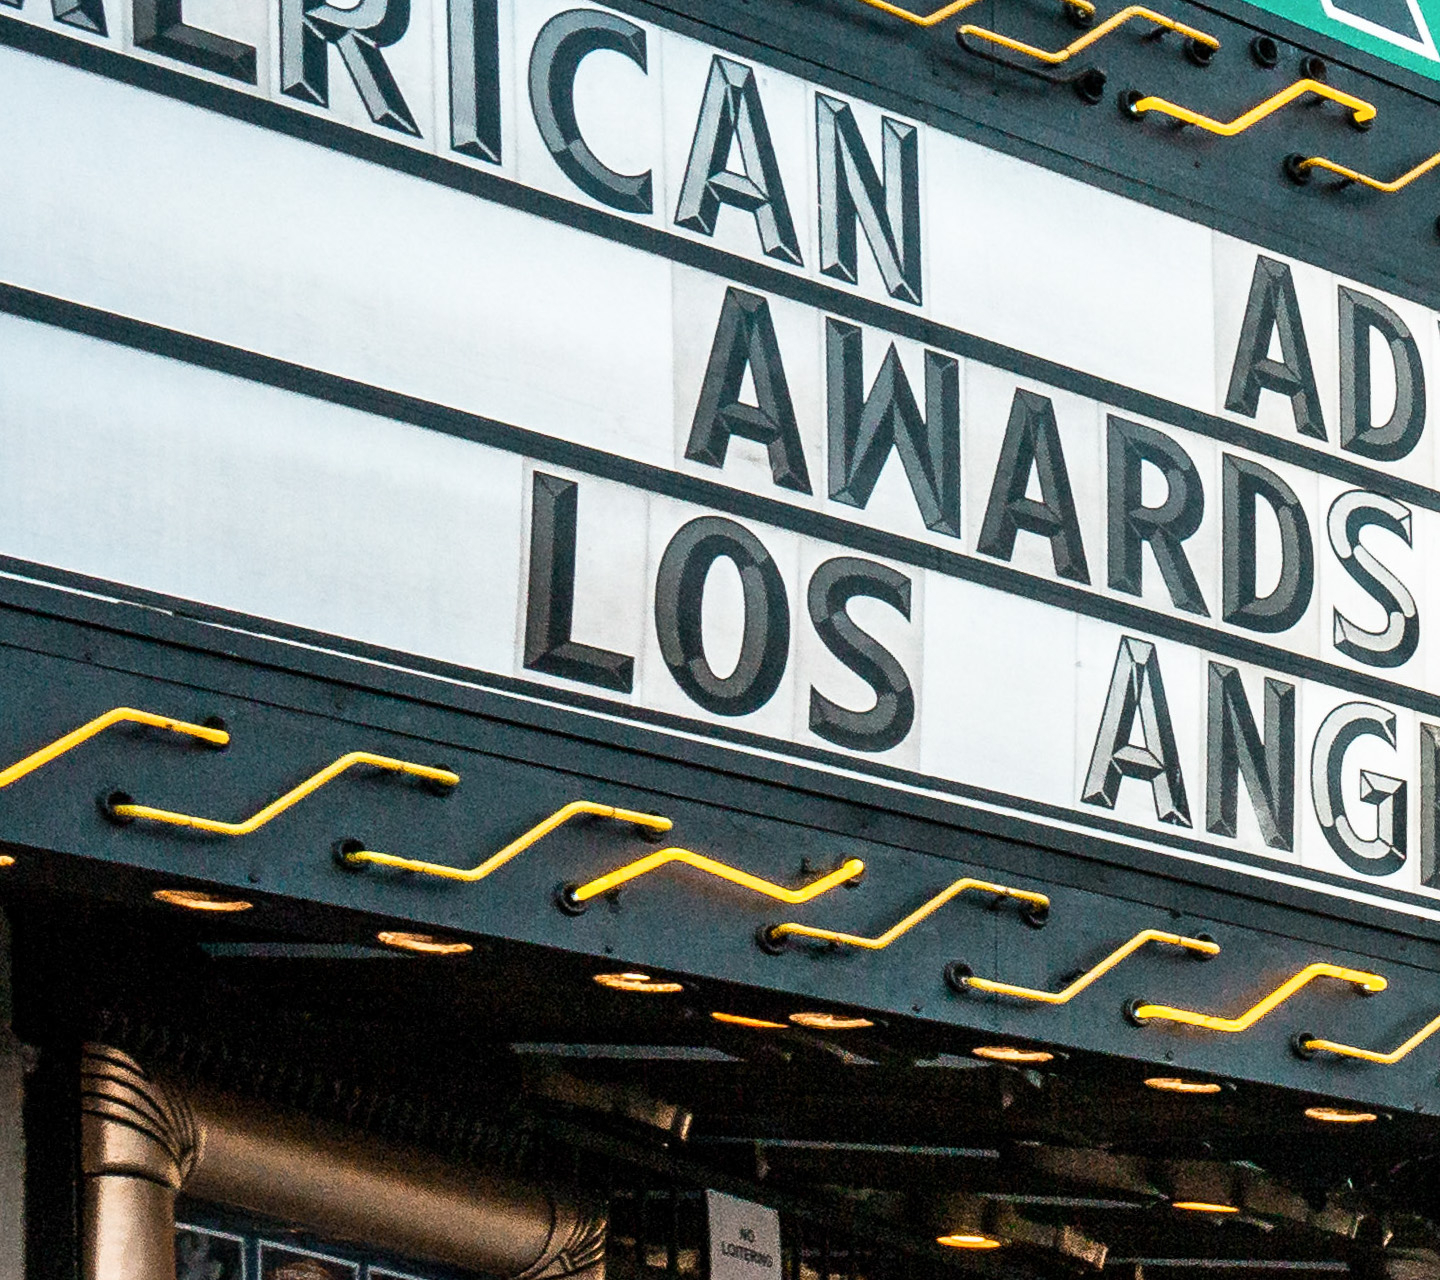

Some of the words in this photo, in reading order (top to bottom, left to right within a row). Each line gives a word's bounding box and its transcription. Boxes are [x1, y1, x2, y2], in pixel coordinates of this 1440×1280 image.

[683, 286, 1420, 667] AWARDS
[521, 470, 918, 754] LOS
[721, 1241, 774, 1268] LOITERING
[740, 1228, 756, 1243] NO
